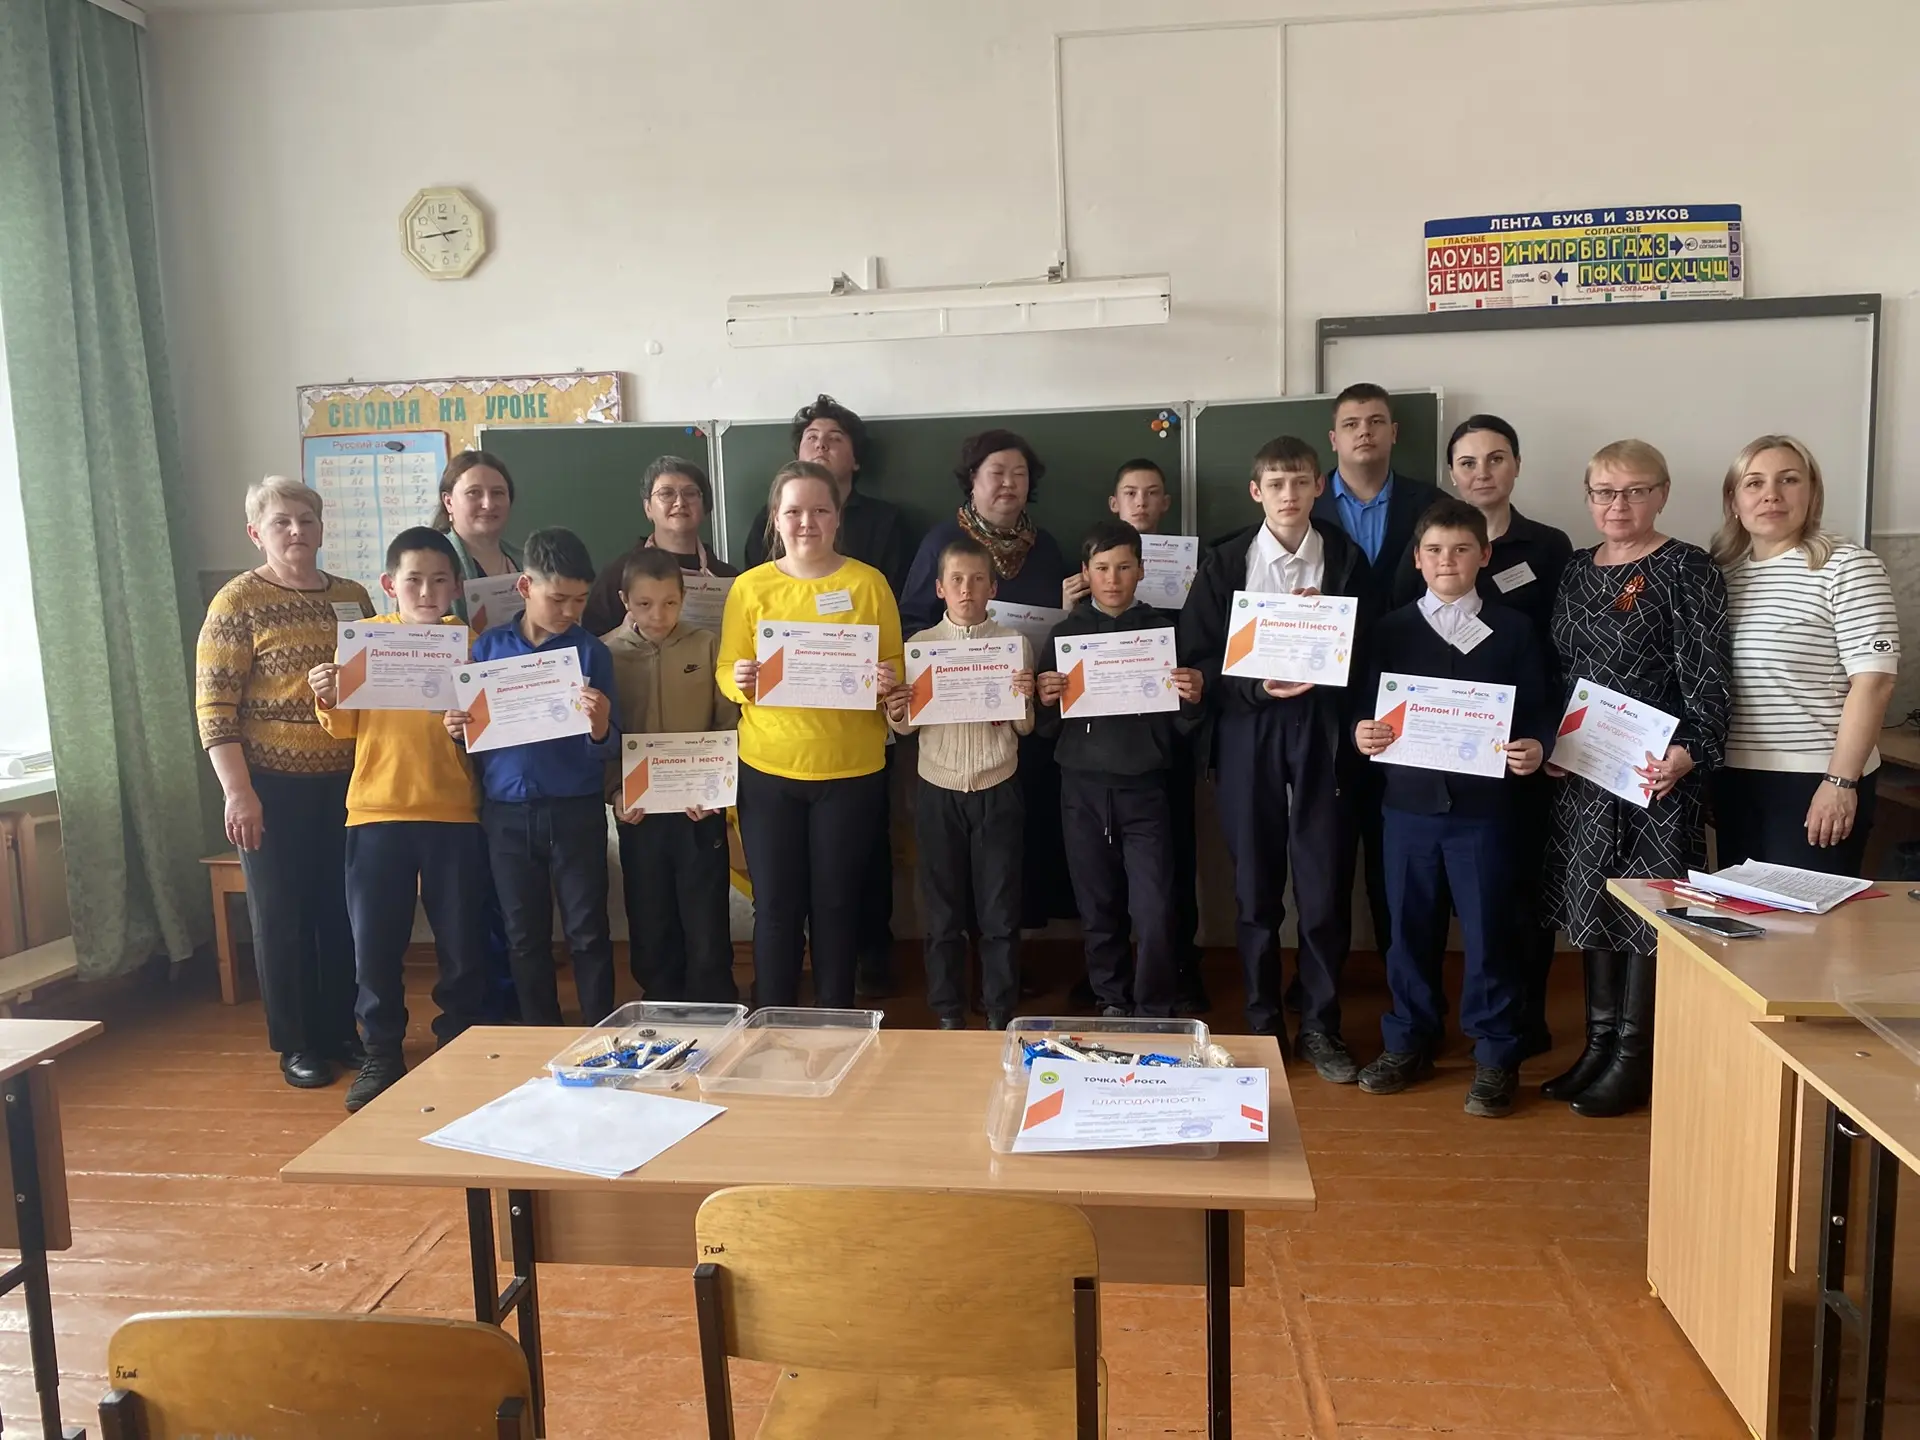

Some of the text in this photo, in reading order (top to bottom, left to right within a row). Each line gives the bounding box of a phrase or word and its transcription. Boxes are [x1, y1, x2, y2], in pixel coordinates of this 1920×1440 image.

[438, 203, 447, 214] 12
[461, 215, 468, 225] 2
[1490, 208, 1690, 230] ЛЕНТА БУКВ И ЗВУКОВ
[466, 228, 473, 238] 3
[1585, 226, 1642, 236] СОГЛАСНЫЕ
[1443, 235, 1486, 245] ГЛАСНЫЕ
[464, 242, 471, 251] 4
[442, 256, 449, 265] 6
[328, 393, 549, 429] СЕГОДНЯ НА УРОКЕ
[333, 440, 372, 451] Русский
[1260, 618, 1296, 629] Диплом
[1310, 622, 1338, 631] место
[370, 648, 409, 658] Диплом
[423, 651, 452, 659] место
[1094, 658, 1120, 666] Диплом
[935, 665, 970, 675] Диплом
[983, 663, 1009, 671] место
[496, 684, 524, 694] Диплом
[1410, 703, 1450, 715] Диплом
[1464, 710, 1495, 720] место
[1596, 720, 1643, 747] БЛАГОДАРНОСТЬ
[651, 757, 686, 766] Диплом
[1091, 1096, 1206, 1106] БЛАГОДАРНОСТЬ
